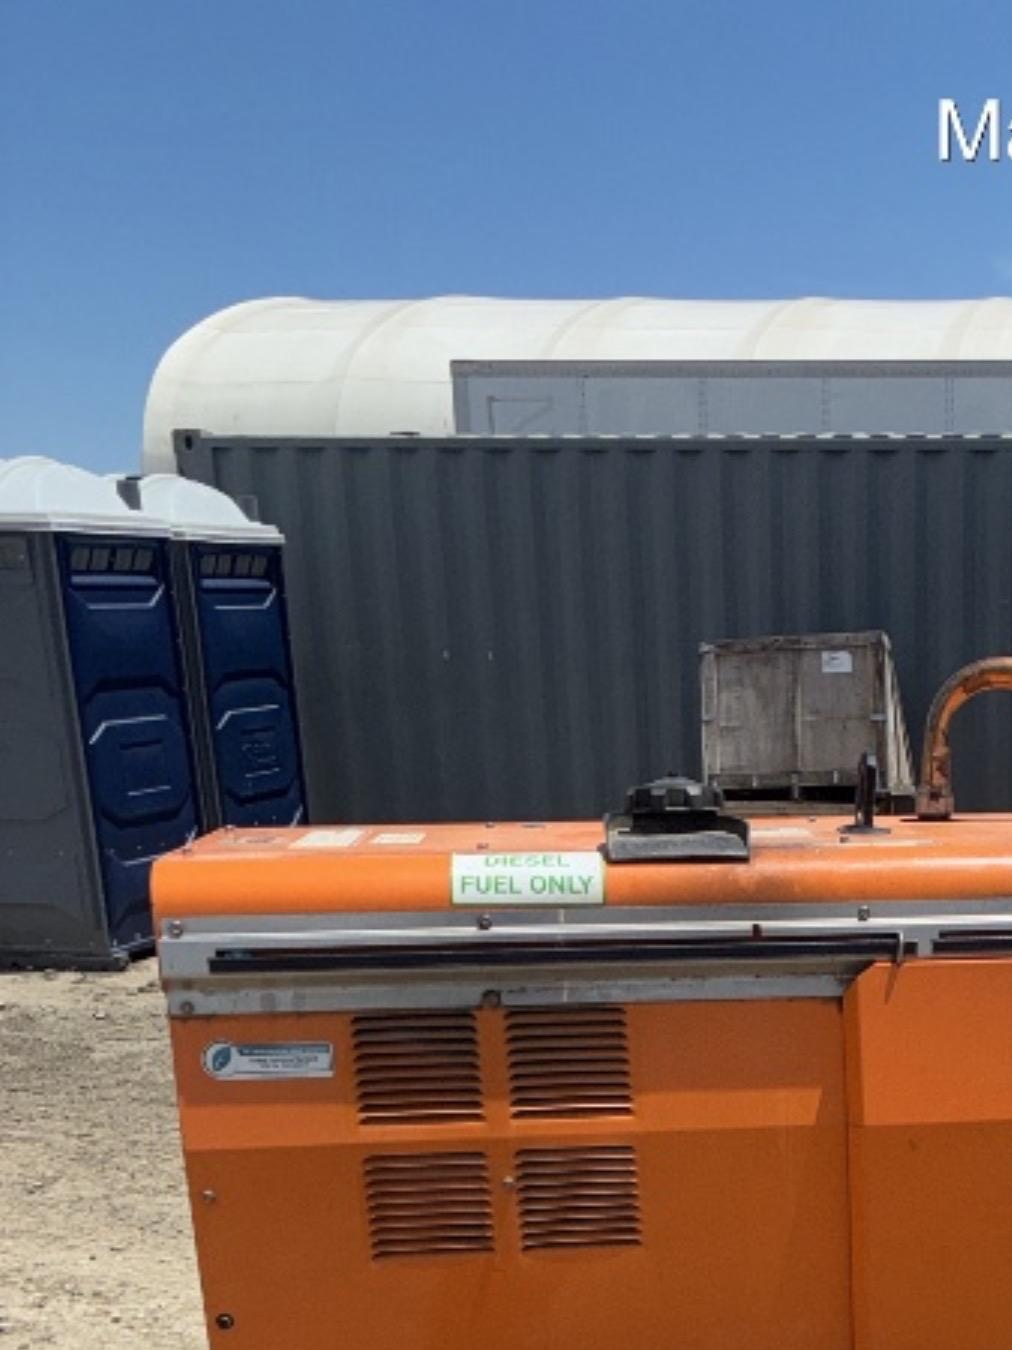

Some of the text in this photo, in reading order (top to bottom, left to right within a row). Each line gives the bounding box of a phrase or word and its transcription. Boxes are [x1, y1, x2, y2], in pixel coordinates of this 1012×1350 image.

[485, 854, 571, 868] DIESEL
[460, 875, 594, 895] FUEL ONLY
